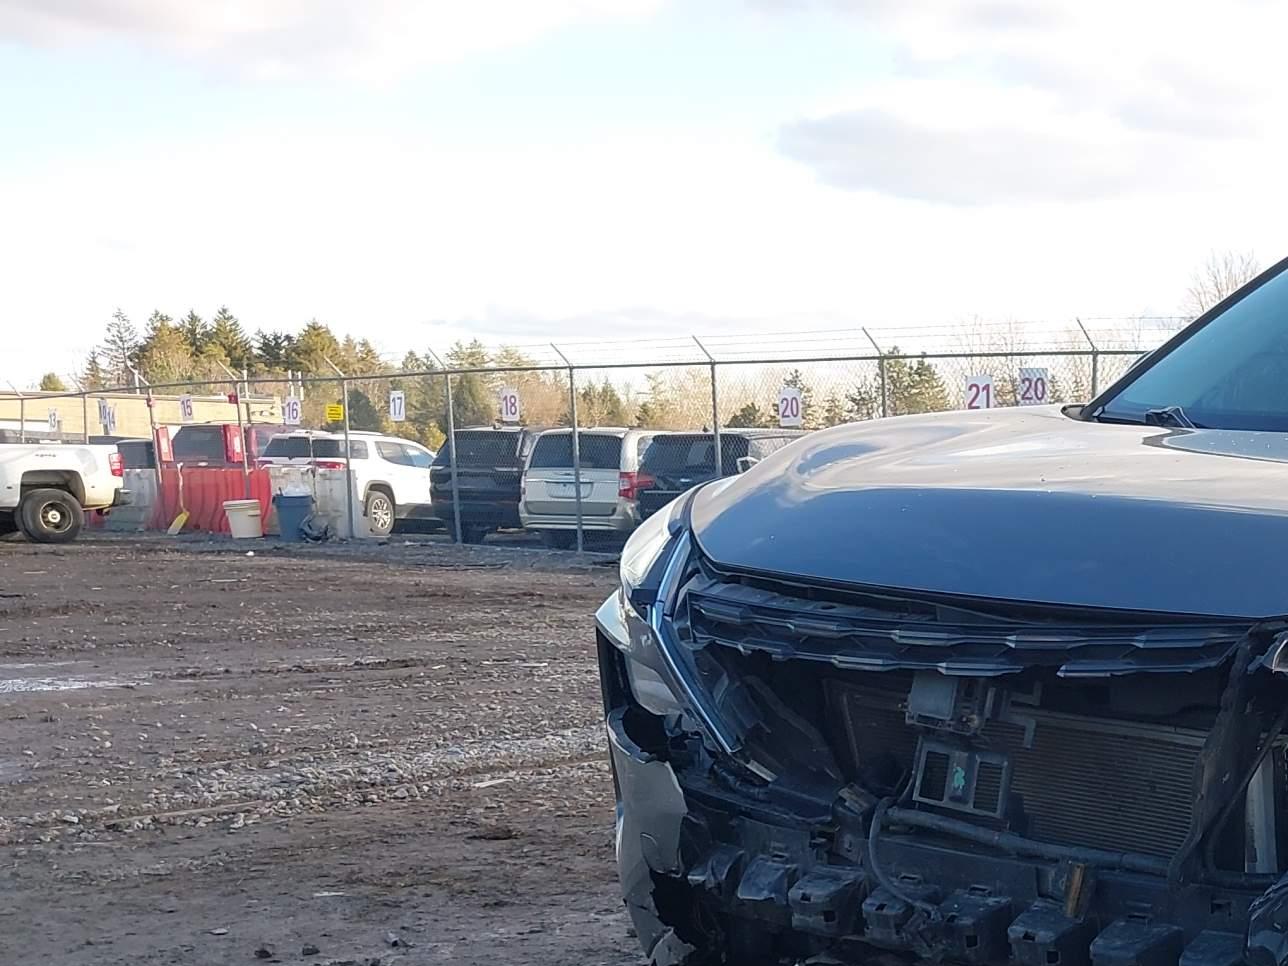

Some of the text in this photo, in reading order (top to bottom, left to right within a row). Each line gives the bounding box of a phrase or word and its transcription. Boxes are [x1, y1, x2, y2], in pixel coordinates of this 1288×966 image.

[967, 383, 990, 409] 21
[1021, 377, 1046, 401] 20
[181, 399, 193, 417] 15
[286, 401, 299, 420] 16
[392, 396, 404, 416] 17
[502, 395, 518, 416] 18
[780, 396, 799, 418] 20
